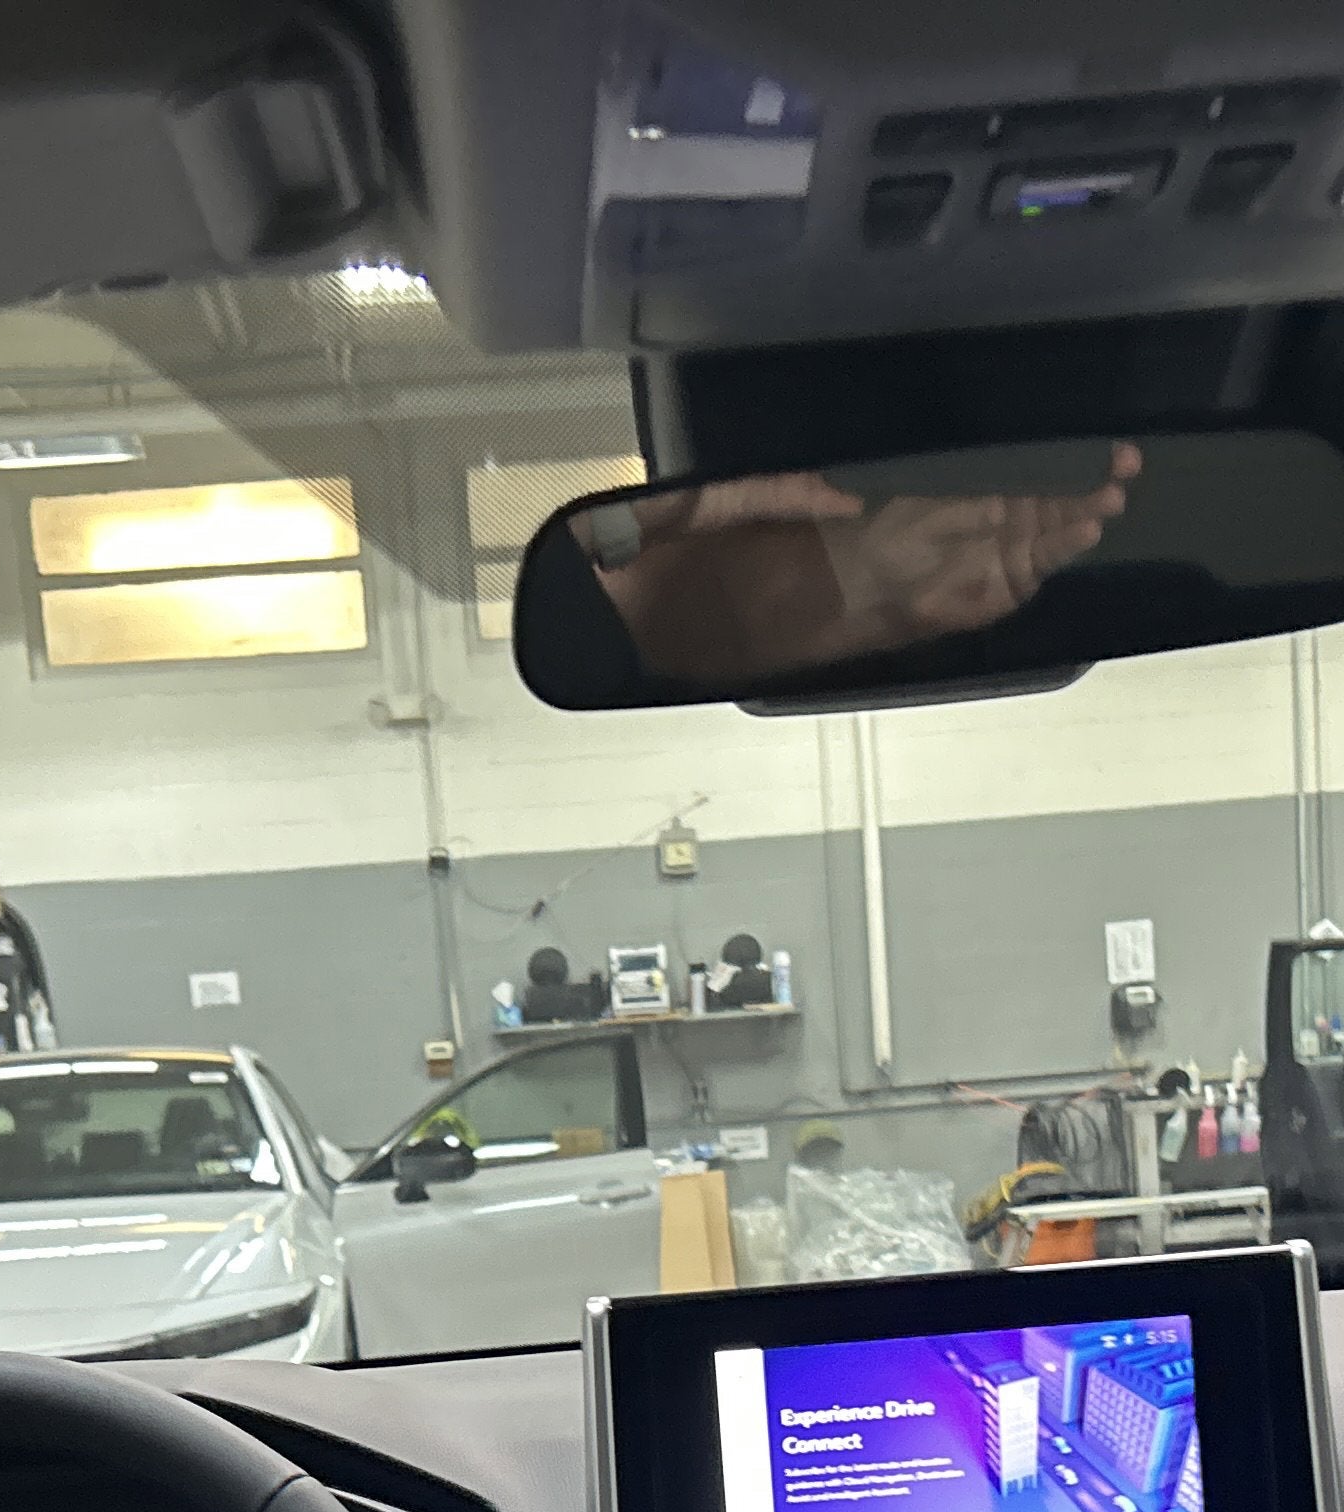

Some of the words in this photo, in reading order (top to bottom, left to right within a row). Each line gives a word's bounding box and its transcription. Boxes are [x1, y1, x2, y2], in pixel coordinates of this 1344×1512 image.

[780, 1405, 884, 1428] Experience
[885, 1399, 935, 1418] Drive
[782, 1433, 863, 1454] Connect
